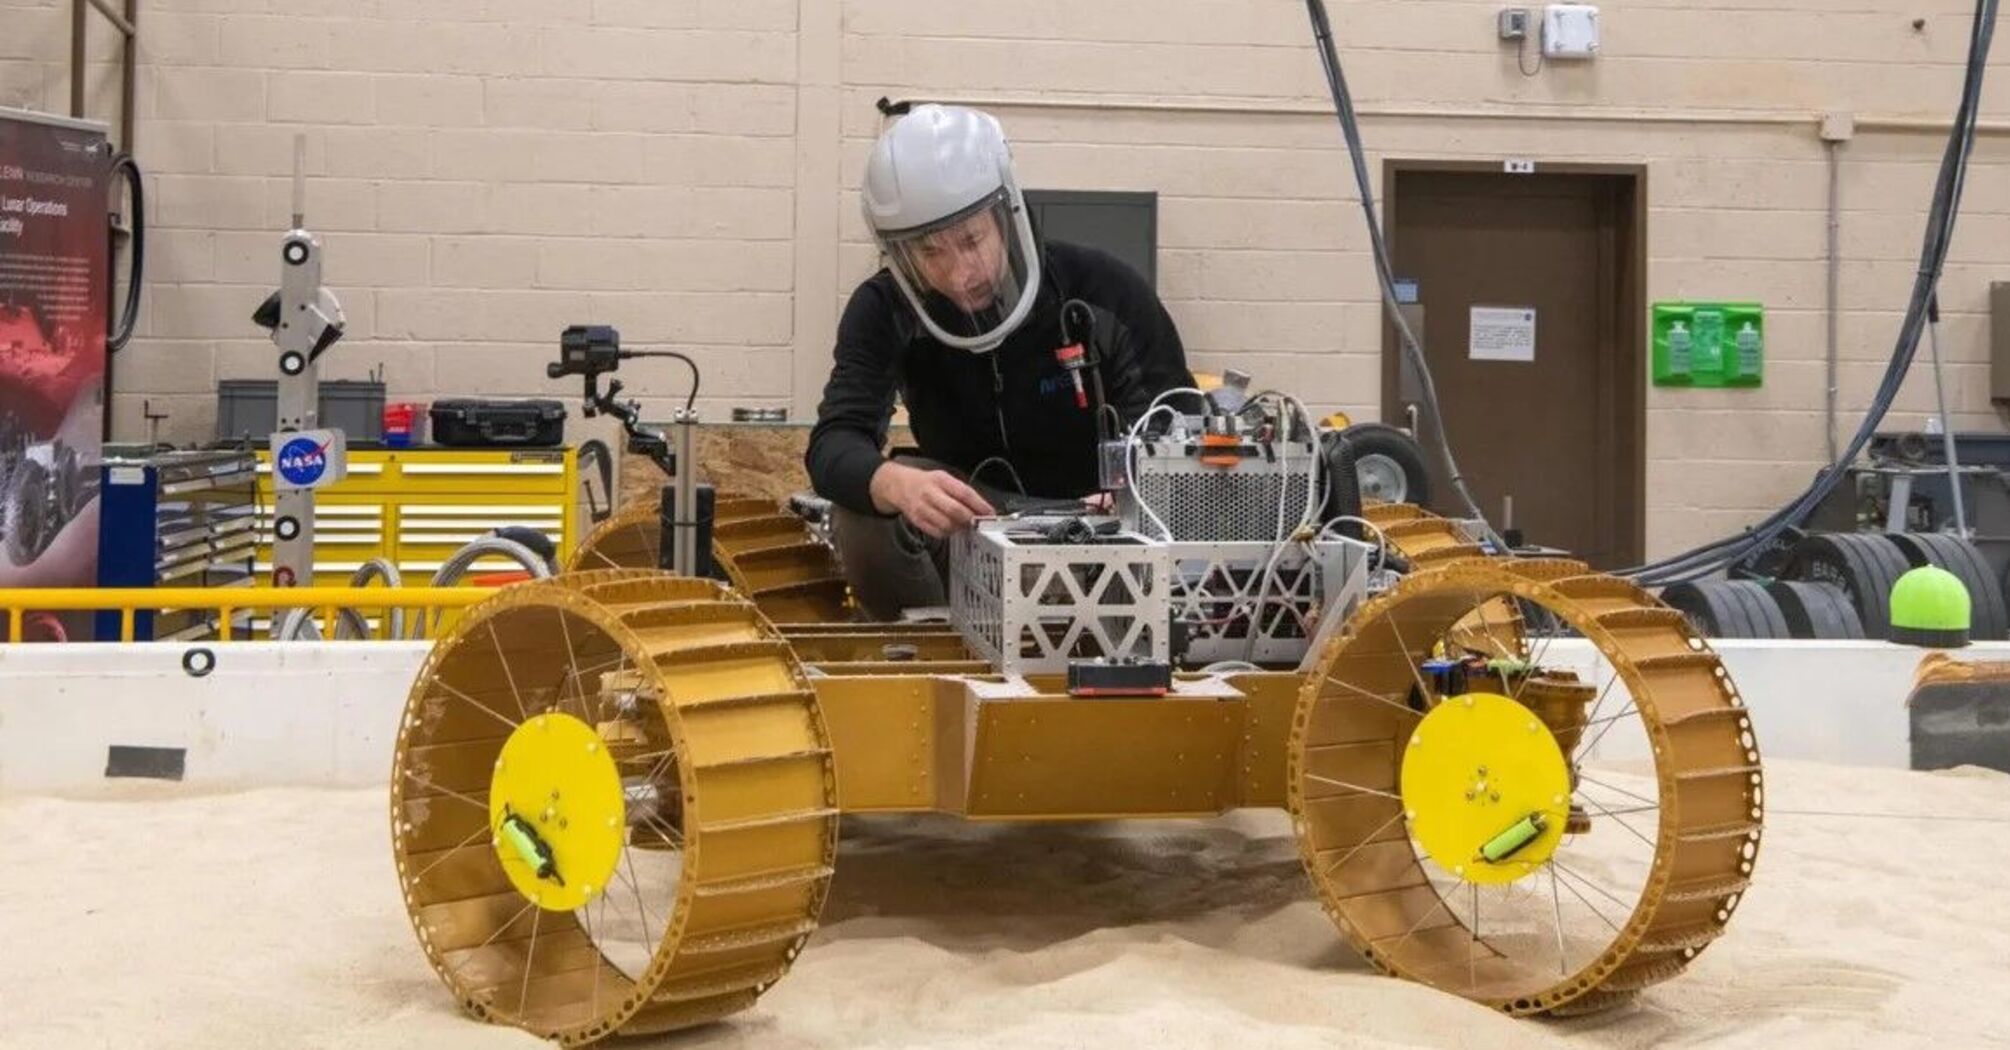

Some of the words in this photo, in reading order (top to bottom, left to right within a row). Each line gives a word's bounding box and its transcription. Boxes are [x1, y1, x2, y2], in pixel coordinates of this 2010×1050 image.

[2, 195, 24, 212] Lunar
[26, 197, 68, 217] Operations
[281, 455, 324, 470] NASA
